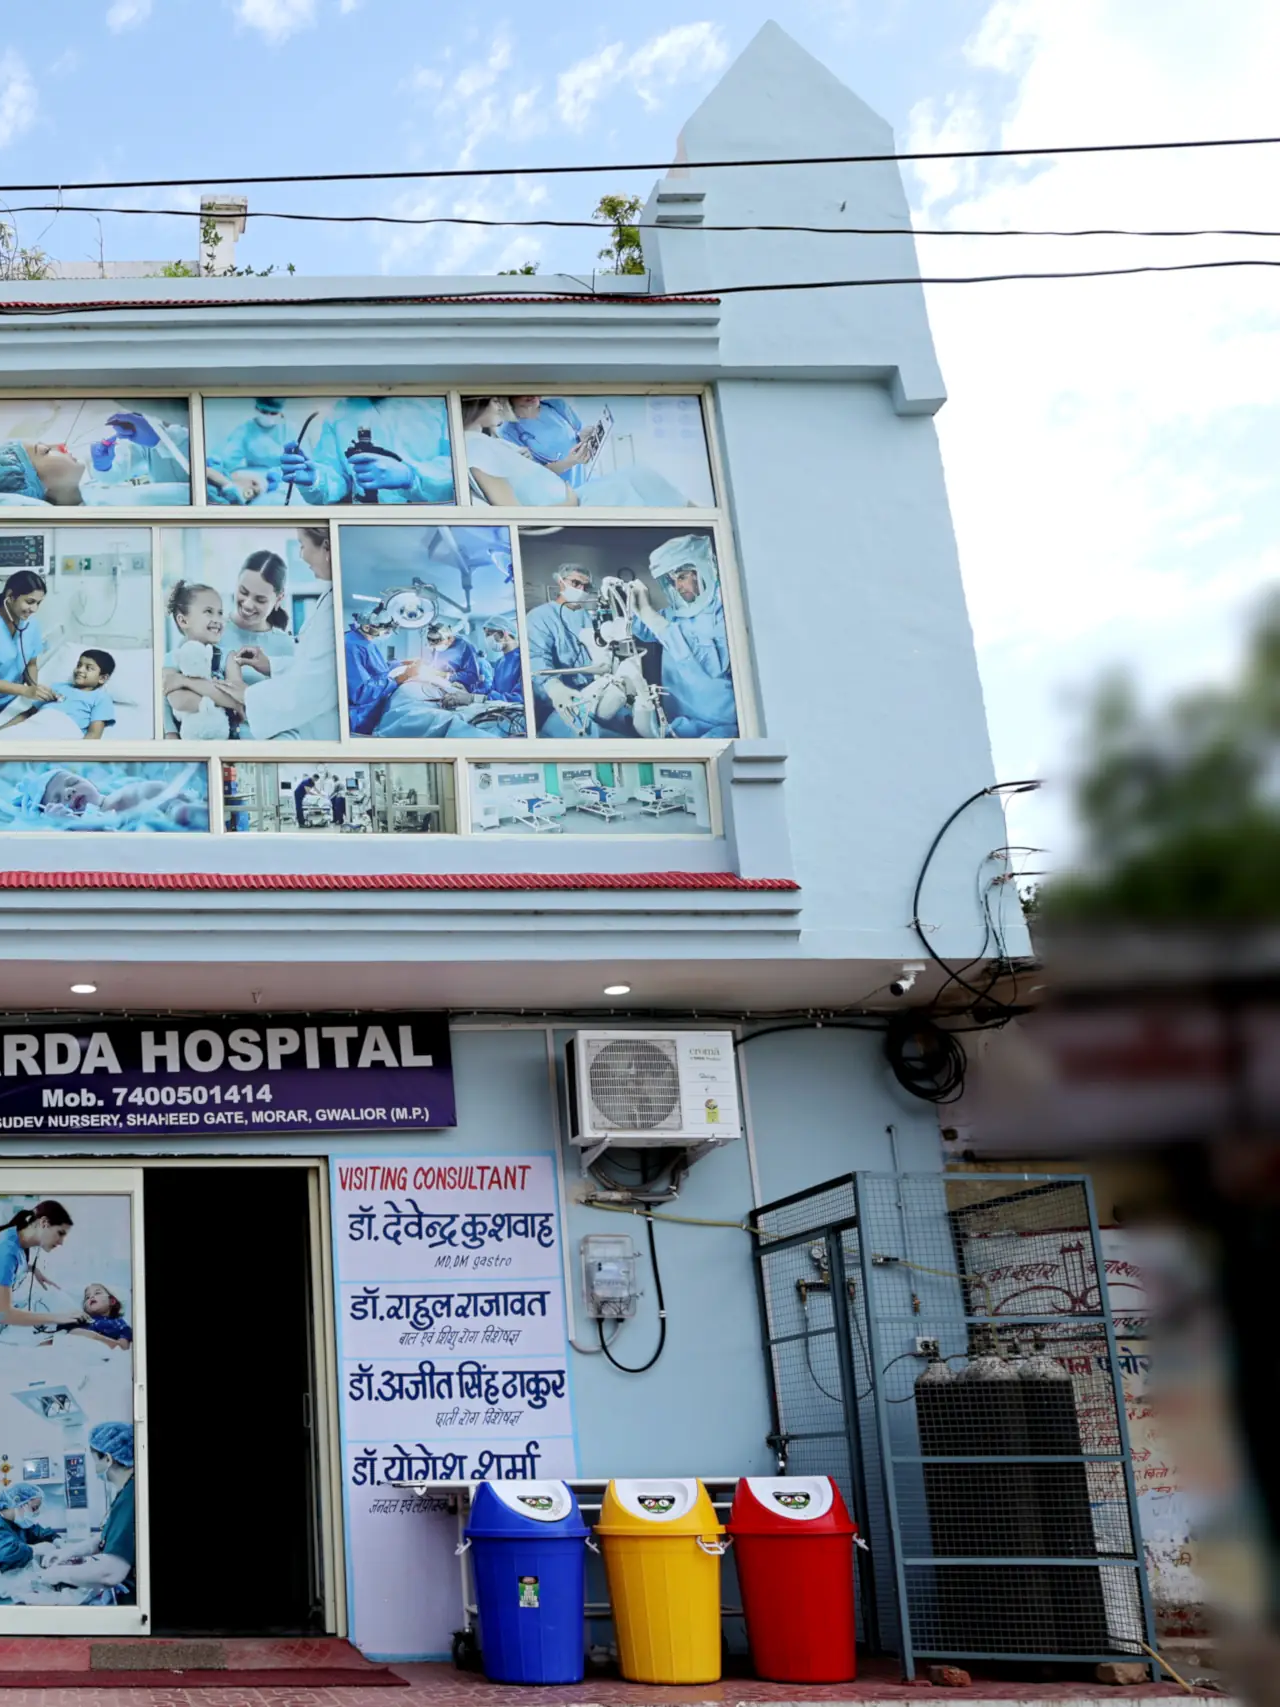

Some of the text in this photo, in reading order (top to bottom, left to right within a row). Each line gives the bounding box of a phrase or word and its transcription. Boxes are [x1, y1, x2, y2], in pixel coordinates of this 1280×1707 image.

[141, 1026, 433, 1073] HOSPITAL
[42, 1084, 273, 1108] Mob. 7400501414
[48, 1114, 123, 1128] NURSERY,
[127, 1112, 199, 1126] SHAHEED
[203, 1111, 248, 1125] GATE,
[251, 1110, 312, 1124] MORAR,
[315, 1108, 387, 1121] GWALIOR
[390, 1107, 430, 1122] (M.P.)
[338, 1165, 531, 1191] VISITING CONSULTANT
[472, 1255, 512, 1270] gastro
[385, 1293, 455, 1331] राहुल
[455, 1290, 551, 1319] राजावत
[456, 1360, 499, 1405] सिंह
[501, 1370, 566, 1409] ठाकुर
